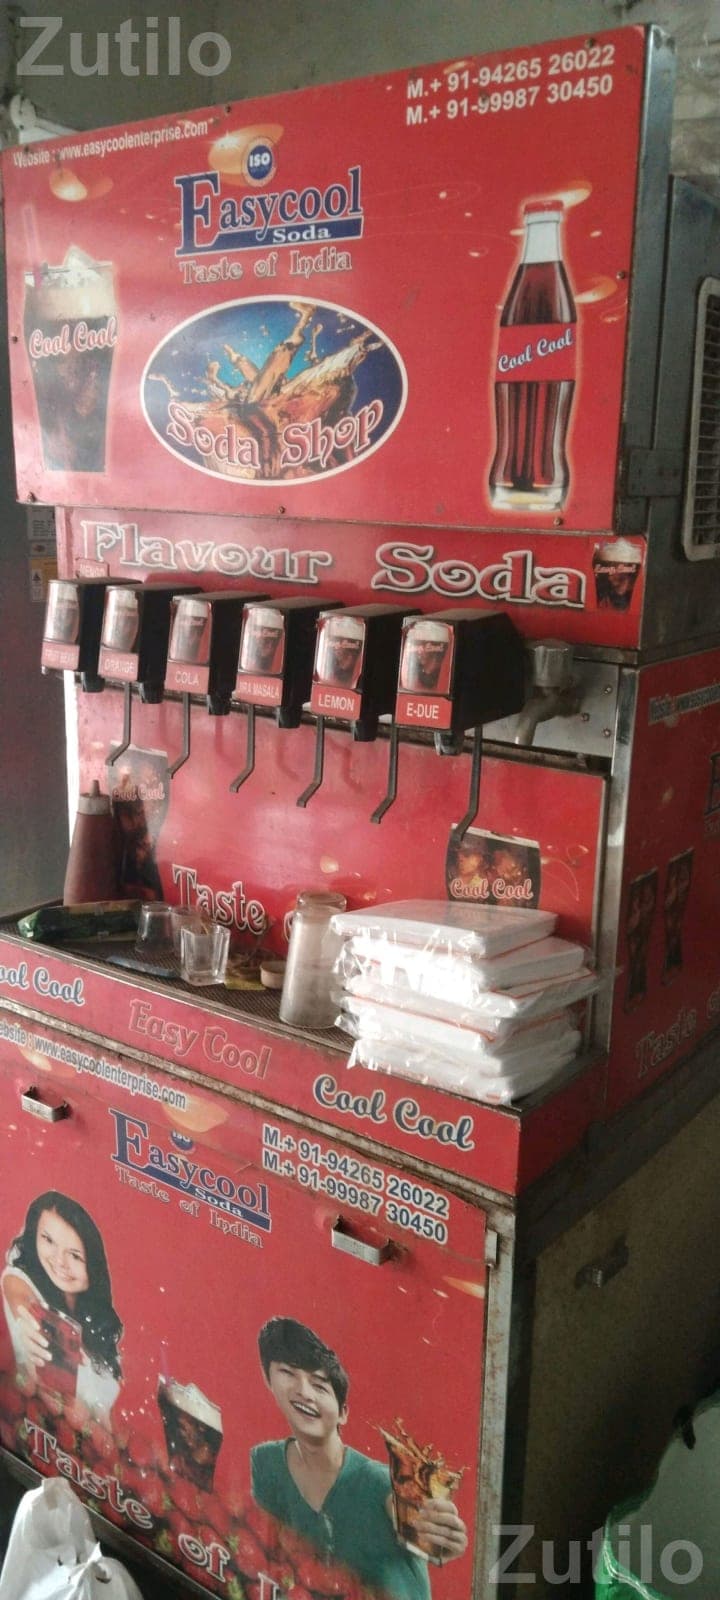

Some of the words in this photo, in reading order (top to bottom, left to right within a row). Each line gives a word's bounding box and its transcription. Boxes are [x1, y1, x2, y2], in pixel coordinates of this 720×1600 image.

[406, 77, 442, 99] M.+
[447, 57, 541, 92] 91-94265
[548, 44, 615, 76] 26022
[406, 104, 441, 126] M.+
[446, 86, 540, 119] 91-99987
[547, 74, 613, 103] 30450
[13, 149, 50, 168] Website
[58, 120, 208, 160] www.easycoolenterprise.com
[249, 153, 270, 168] ISO
[174, 165, 364, 257] Easycool
[272, 225, 331, 244] Soda
[179, 257, 243, 284] Taste
[254, 251, 279, 278] of
[290, 247, 352, 279] India
[29, 325, 71, 359] Cool
[73, 312, 118, 350] Cool
[498, 344, 532, 372] Cool
[537, 328, 574, 356] Cool
[166, 399, 262, 470] Soda
[280, 399, 384, 469] Shop
[80, 520, 334, 584] Flavour
[371, 541, 587, 609] Soda
[104, 658, 135, 674] ORANGE
[175, 670, 200, 686] COLA
[252, 682, 280, 698] MASALA
[318, 693, 354, 711] LEMON
[406, 702, 440, 719] E-DUE
[138, 781, 165, 801] Cool
[171, 863, 266, 935] Taste
[450, 878, 490, 900] Cool
[491, 878, 534, 900] Cool
[0, 961, 30, 990] ool
[33, 967, 85, 1006] Cool
[129, 998, 200, 1057] Easy
[203, 1025, 272, 1080] Cool
[33, 1033, 187, 1112] www.easycoolenterprise.com
[313, 1074, 386, 1123] Cool
[393, 1098, 475, 1150] Cool
[108, 1107, 272, 1232] Easycool
[262, 1123, 294, 1151] M.+
[298, 1138, 384, 1189] 91-94265
[386, 1176, 450, 1220] 26022
[114, 1164, 170, 1203] Taste
[179, 1199, 200, 1218] of
[210, 1206, 264, 1249] India
[194, 1187, 244, 1218] Soda
[262, 1149, 294, 1178] M.+
[298, 1163, 381, 1215] 91-99987
[385, 1202, 448, 1245] 30450
[24, 1417, 153, 1529] Taste
[178, 1533, 230, 1583] of
